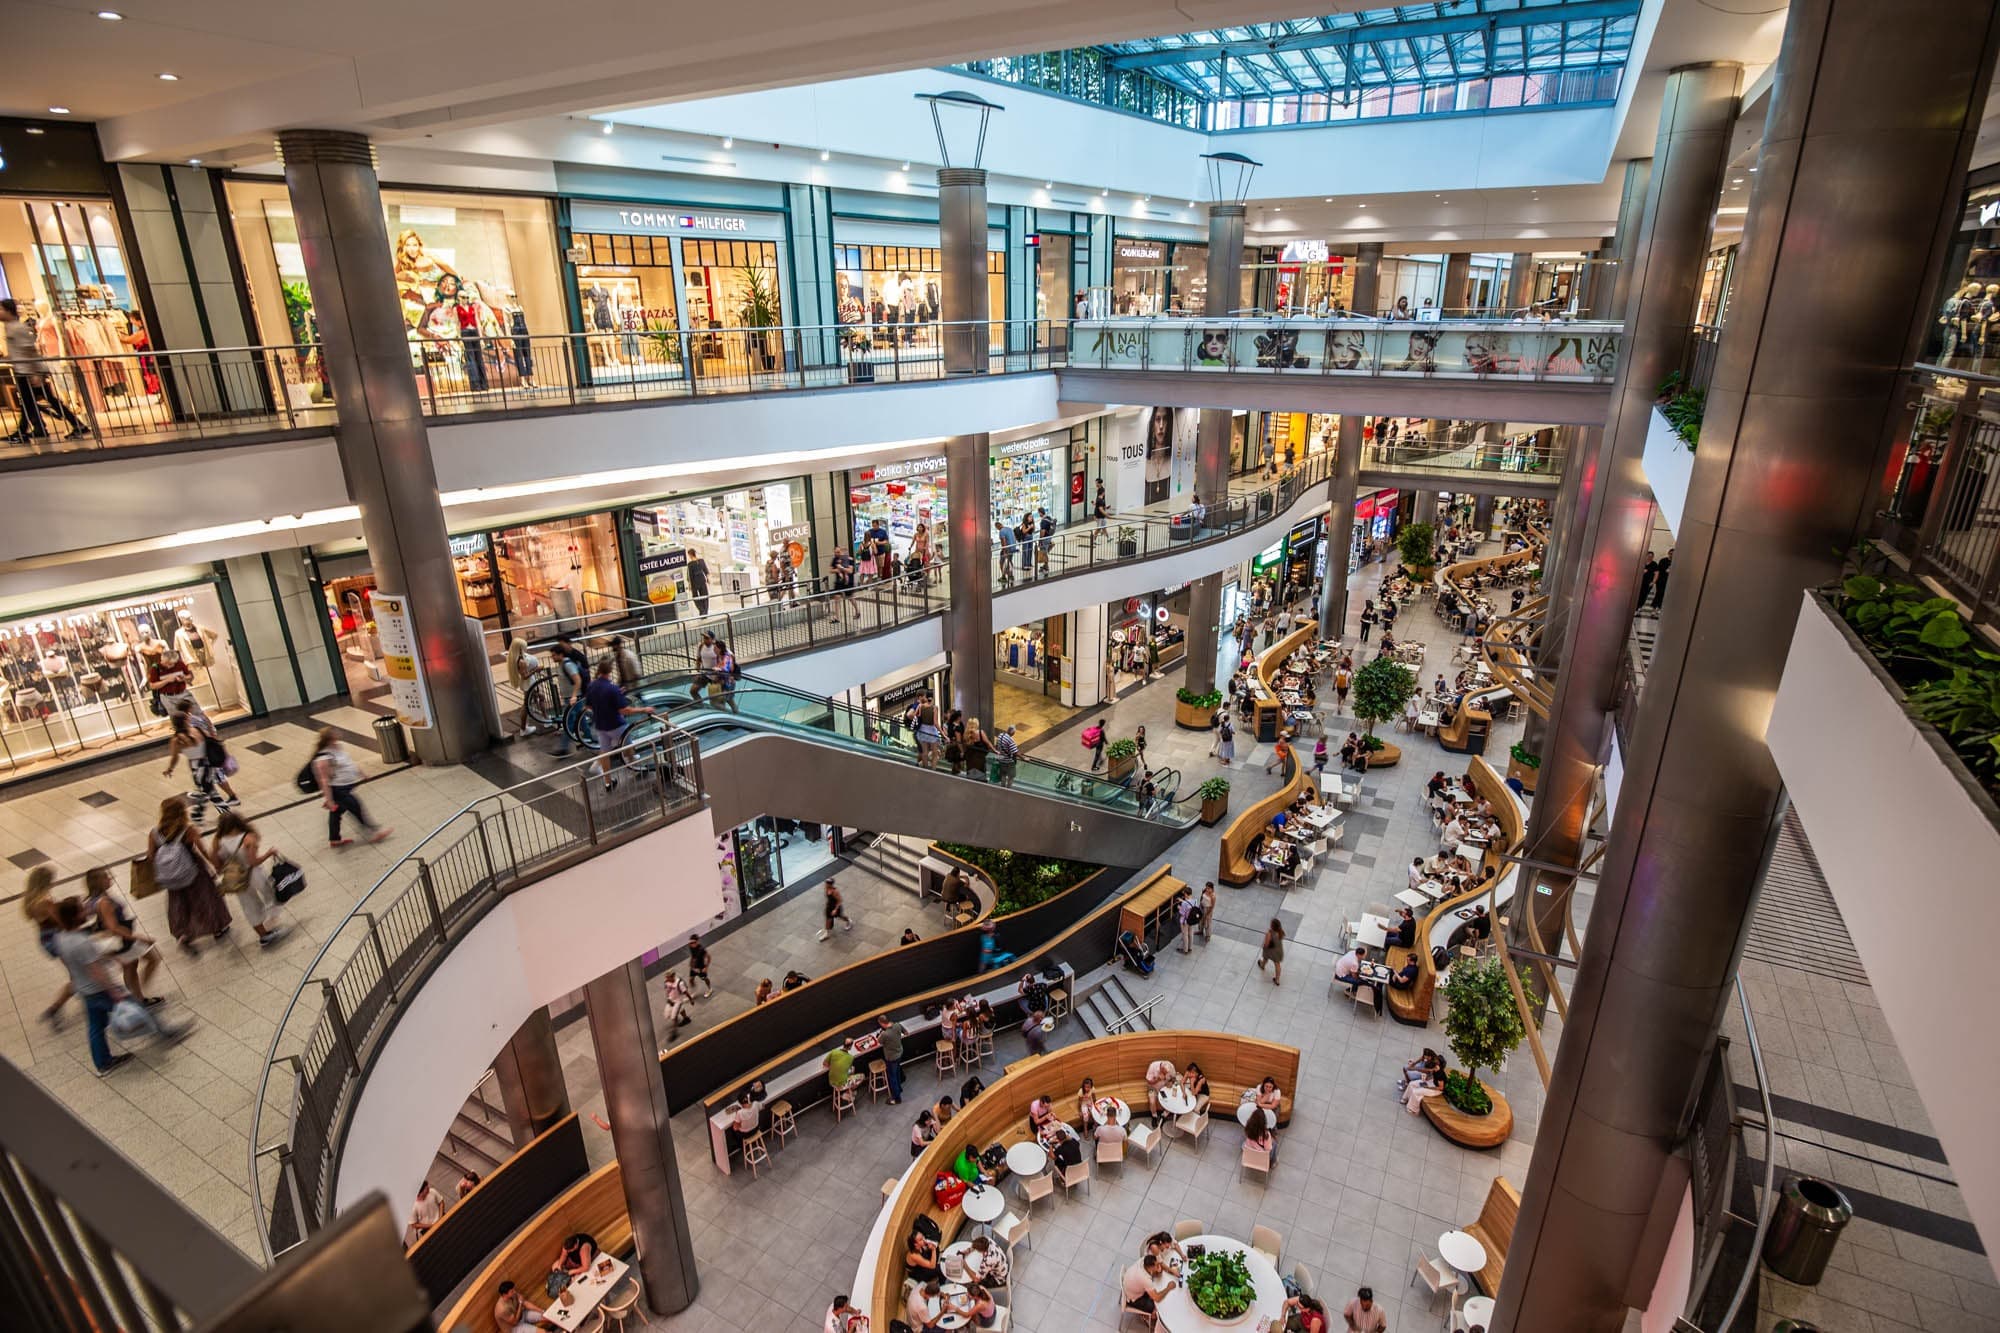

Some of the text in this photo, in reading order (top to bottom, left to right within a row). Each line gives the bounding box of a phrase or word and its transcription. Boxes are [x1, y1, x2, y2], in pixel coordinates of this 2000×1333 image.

[619, 212, 746, 231] TOMMY HILFIGER
[1000, 439, 1029, 454] westend
[1122, 443, 1144, 460] TOUS
[773, 525, 809, 542] CLINIQUE
[659, 554, 685, 567] LAUDER
[884, 688, 903, 702] ROUGE
